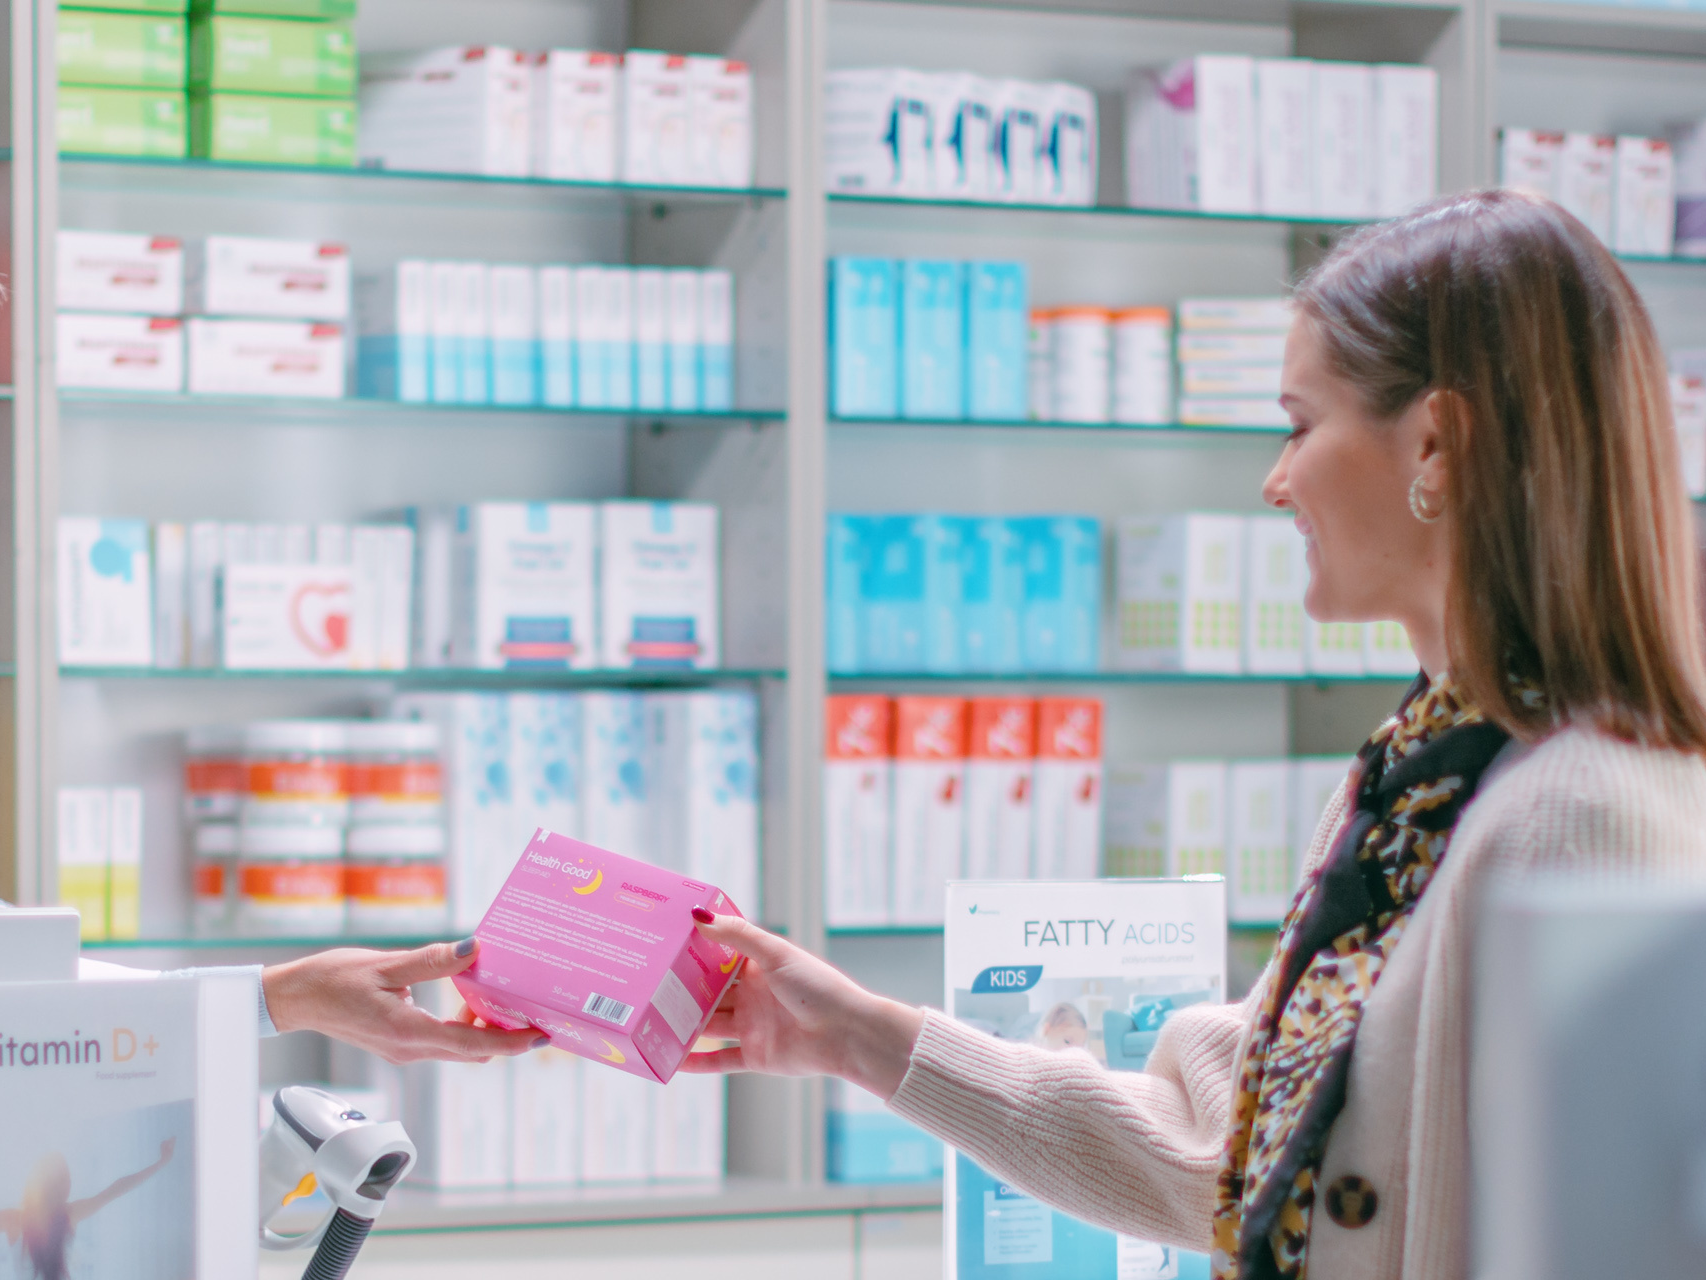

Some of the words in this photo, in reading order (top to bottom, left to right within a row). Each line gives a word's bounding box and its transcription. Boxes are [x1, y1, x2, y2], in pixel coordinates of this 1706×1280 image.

[525, 850, 561, 872] Health
[560, 862, 594, 881] Good
[620, 881, 671, 904] RASPBERRY
[1024, 919, 1115, 947] FATTY
[1123, 922, 1195, 945] ACIDS
[989, 970, 1028, 987] KIDS
[478, 996, 539, 1026] Health
[535, 1016, 584, 1043] Good
[96, 1071, 115, 1081] Food
[116, 1069, 157, 1081] supplement
